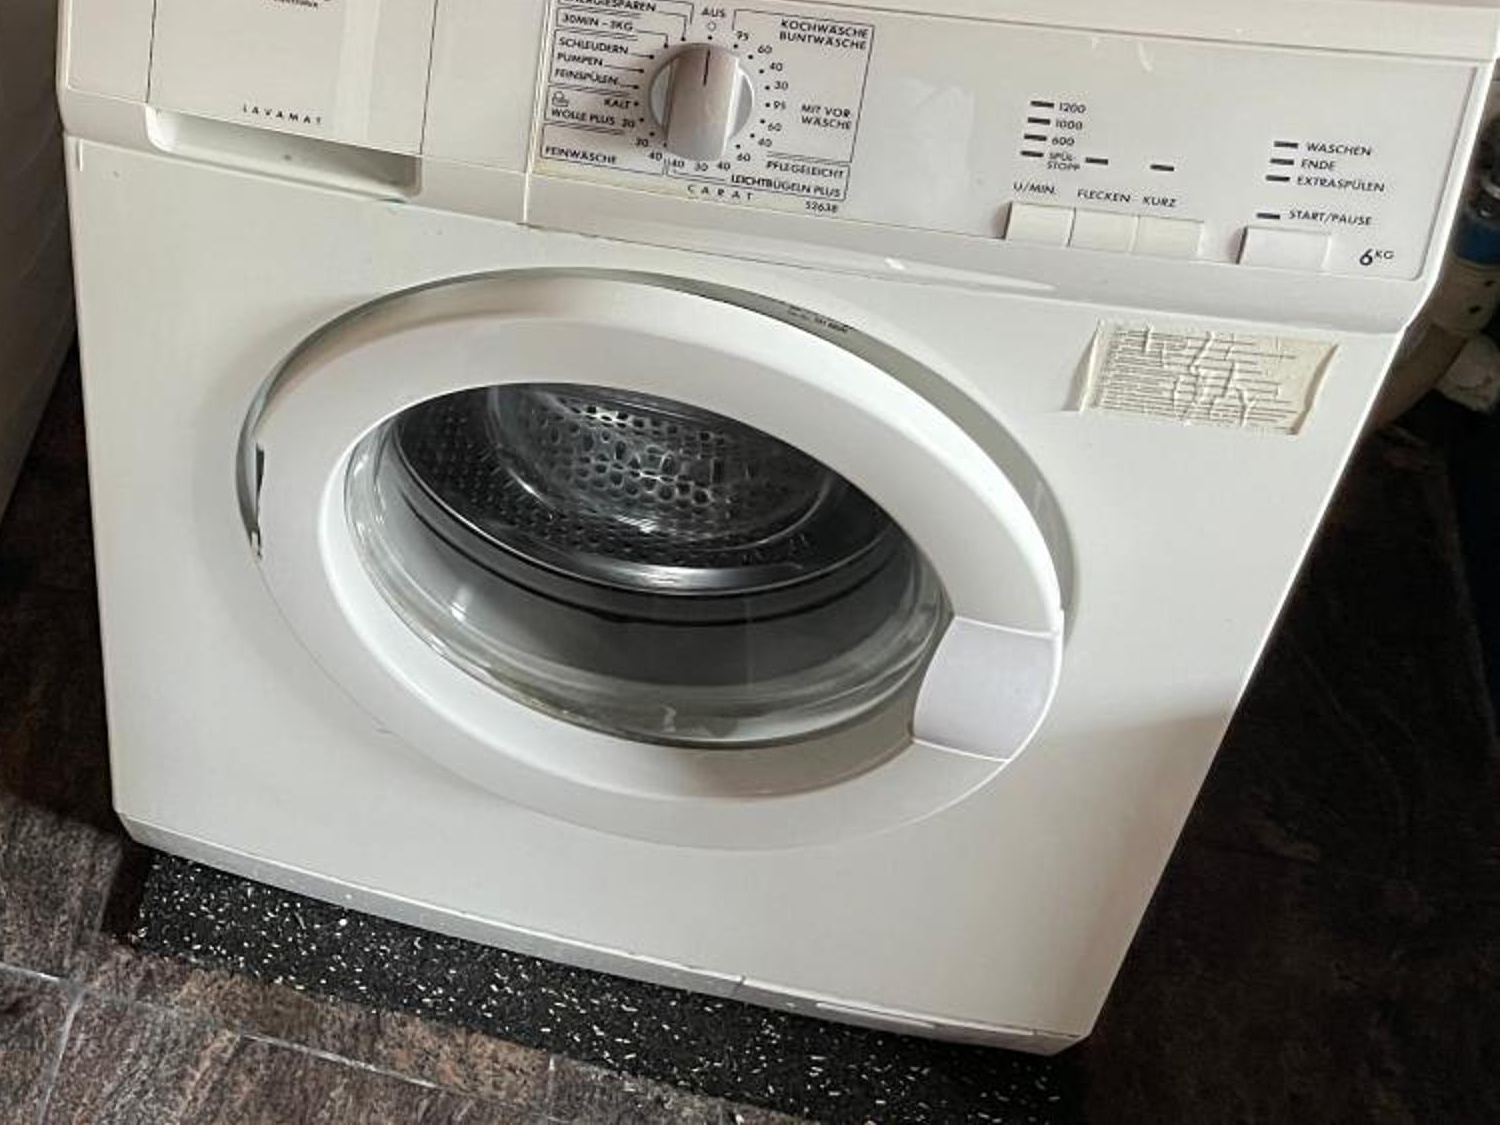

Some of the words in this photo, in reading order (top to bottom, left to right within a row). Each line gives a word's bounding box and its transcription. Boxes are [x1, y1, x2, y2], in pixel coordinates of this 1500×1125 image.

[701, 7, 727, 19] AUS
[559, 37, 629, 55] SCHLEUDERN
[757, 44, 773, 55] 60
[557, 52, 603, 67] PUMPEN
[770, 62, 784, 72] 40
[773, 81, 790, 92] 30
[603, 98, 631, 110] KALT
[1059, 102, 1087, 114] 1200
[243, 102, 323, 125] LAVAMAT
[551, 109, 586, 121] WOLLE
[589, 115, 616, 126] PLUS
[824, 106, 852, 119] VOR
[767, 122, 783, 132] 60
[1055, 118, 1084, 131] 1000
[758, 137, 773, 148] 40
[1051, 136, 1076, 147] 600
[1306, 141, 1373, 157] WASCHEN
[649, 151, 663, 162] 40
[717, 160, 731, 171] 40
[766, 160, 845, 180] PFLEGELEICHT
[1047, 160, 1081, 171] STOPP
[1301, 158, 1337, 171] ENDE
[1297, 175, 1386, 193] EXTRASPÜLEN
[687, 184, 753, 201] CARAT
[813, 185, 841, 199] PLUS
[1077, 188, 1131, 203] FLECKEN
[805, 200, 840, 214] 52638
[1141, 195, 1178, 208] KURZ
[1288, 210, 1373, 227] START/PAUSE
